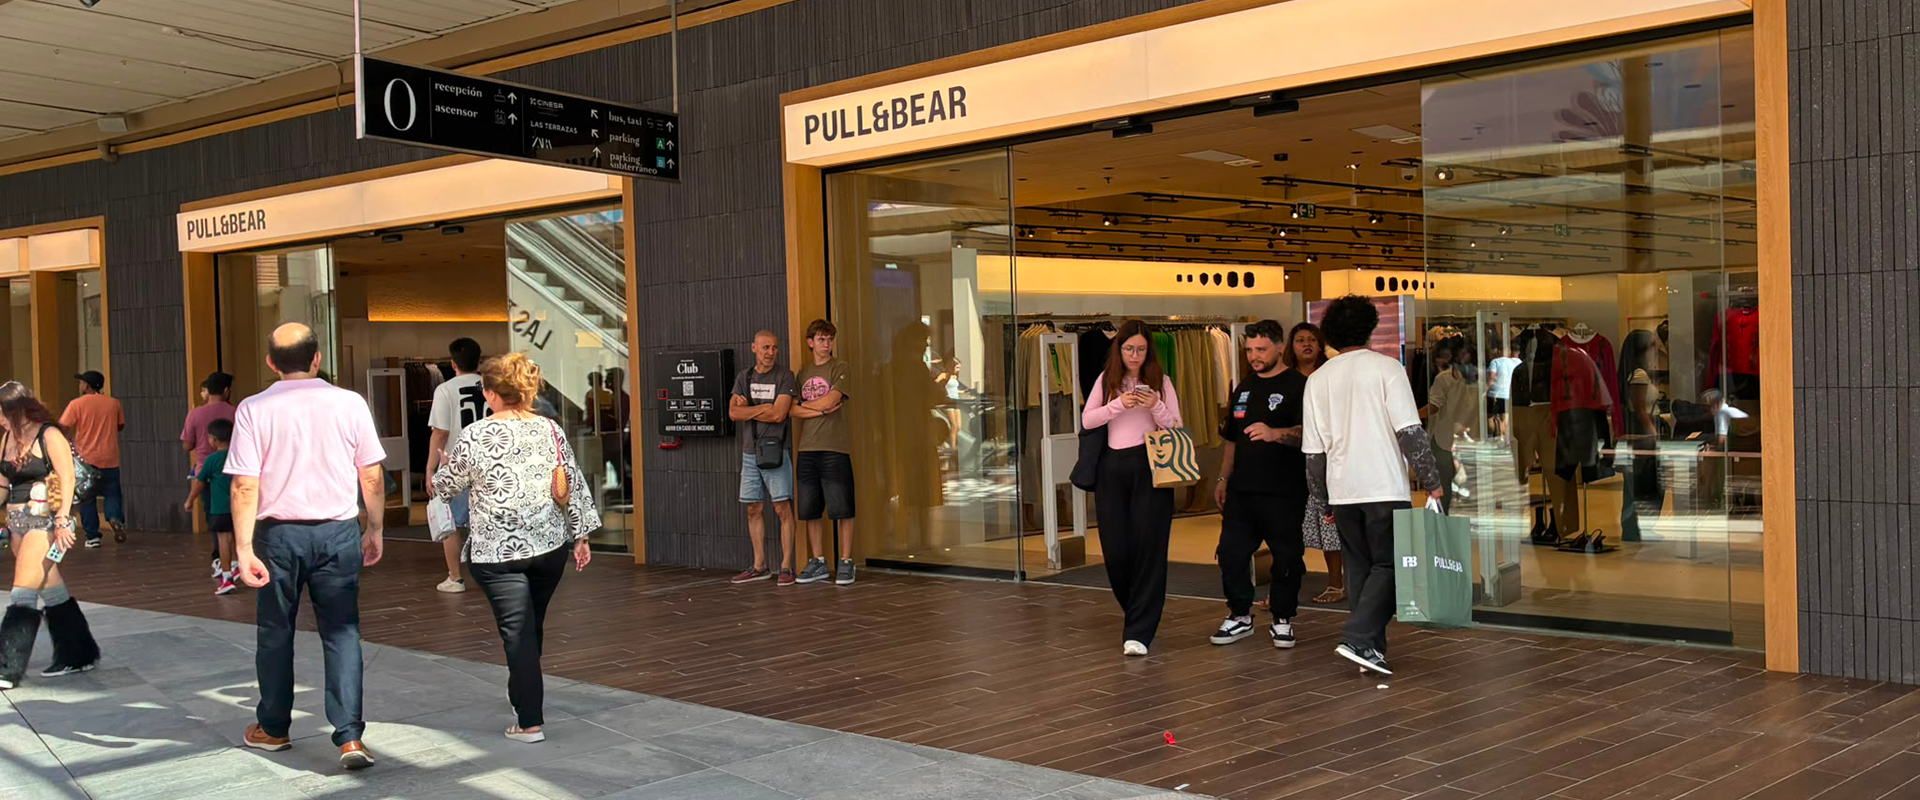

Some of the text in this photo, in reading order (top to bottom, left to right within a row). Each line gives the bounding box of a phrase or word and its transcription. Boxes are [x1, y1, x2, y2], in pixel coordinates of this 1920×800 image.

[434, 82, 483, 98] recepción
[434, 104, 479, 118] ascensor
[536, 99, 564, 109] CINESA
[608, 111, 642, 126] bus, taxi
[804, 85, 967, 146] PULL&BEAR
[530, 120, 578, 134] LAS TERRAZAS
[609, 133, 640, 147] parking
[656, 139, 665, 149] A
[609, 152, 641, 165] parking
[609, 161, 658, 174] subterráneo
[187, 209, 266, 241] PULL&BEAR
[677, 363, 698, 374] Club
